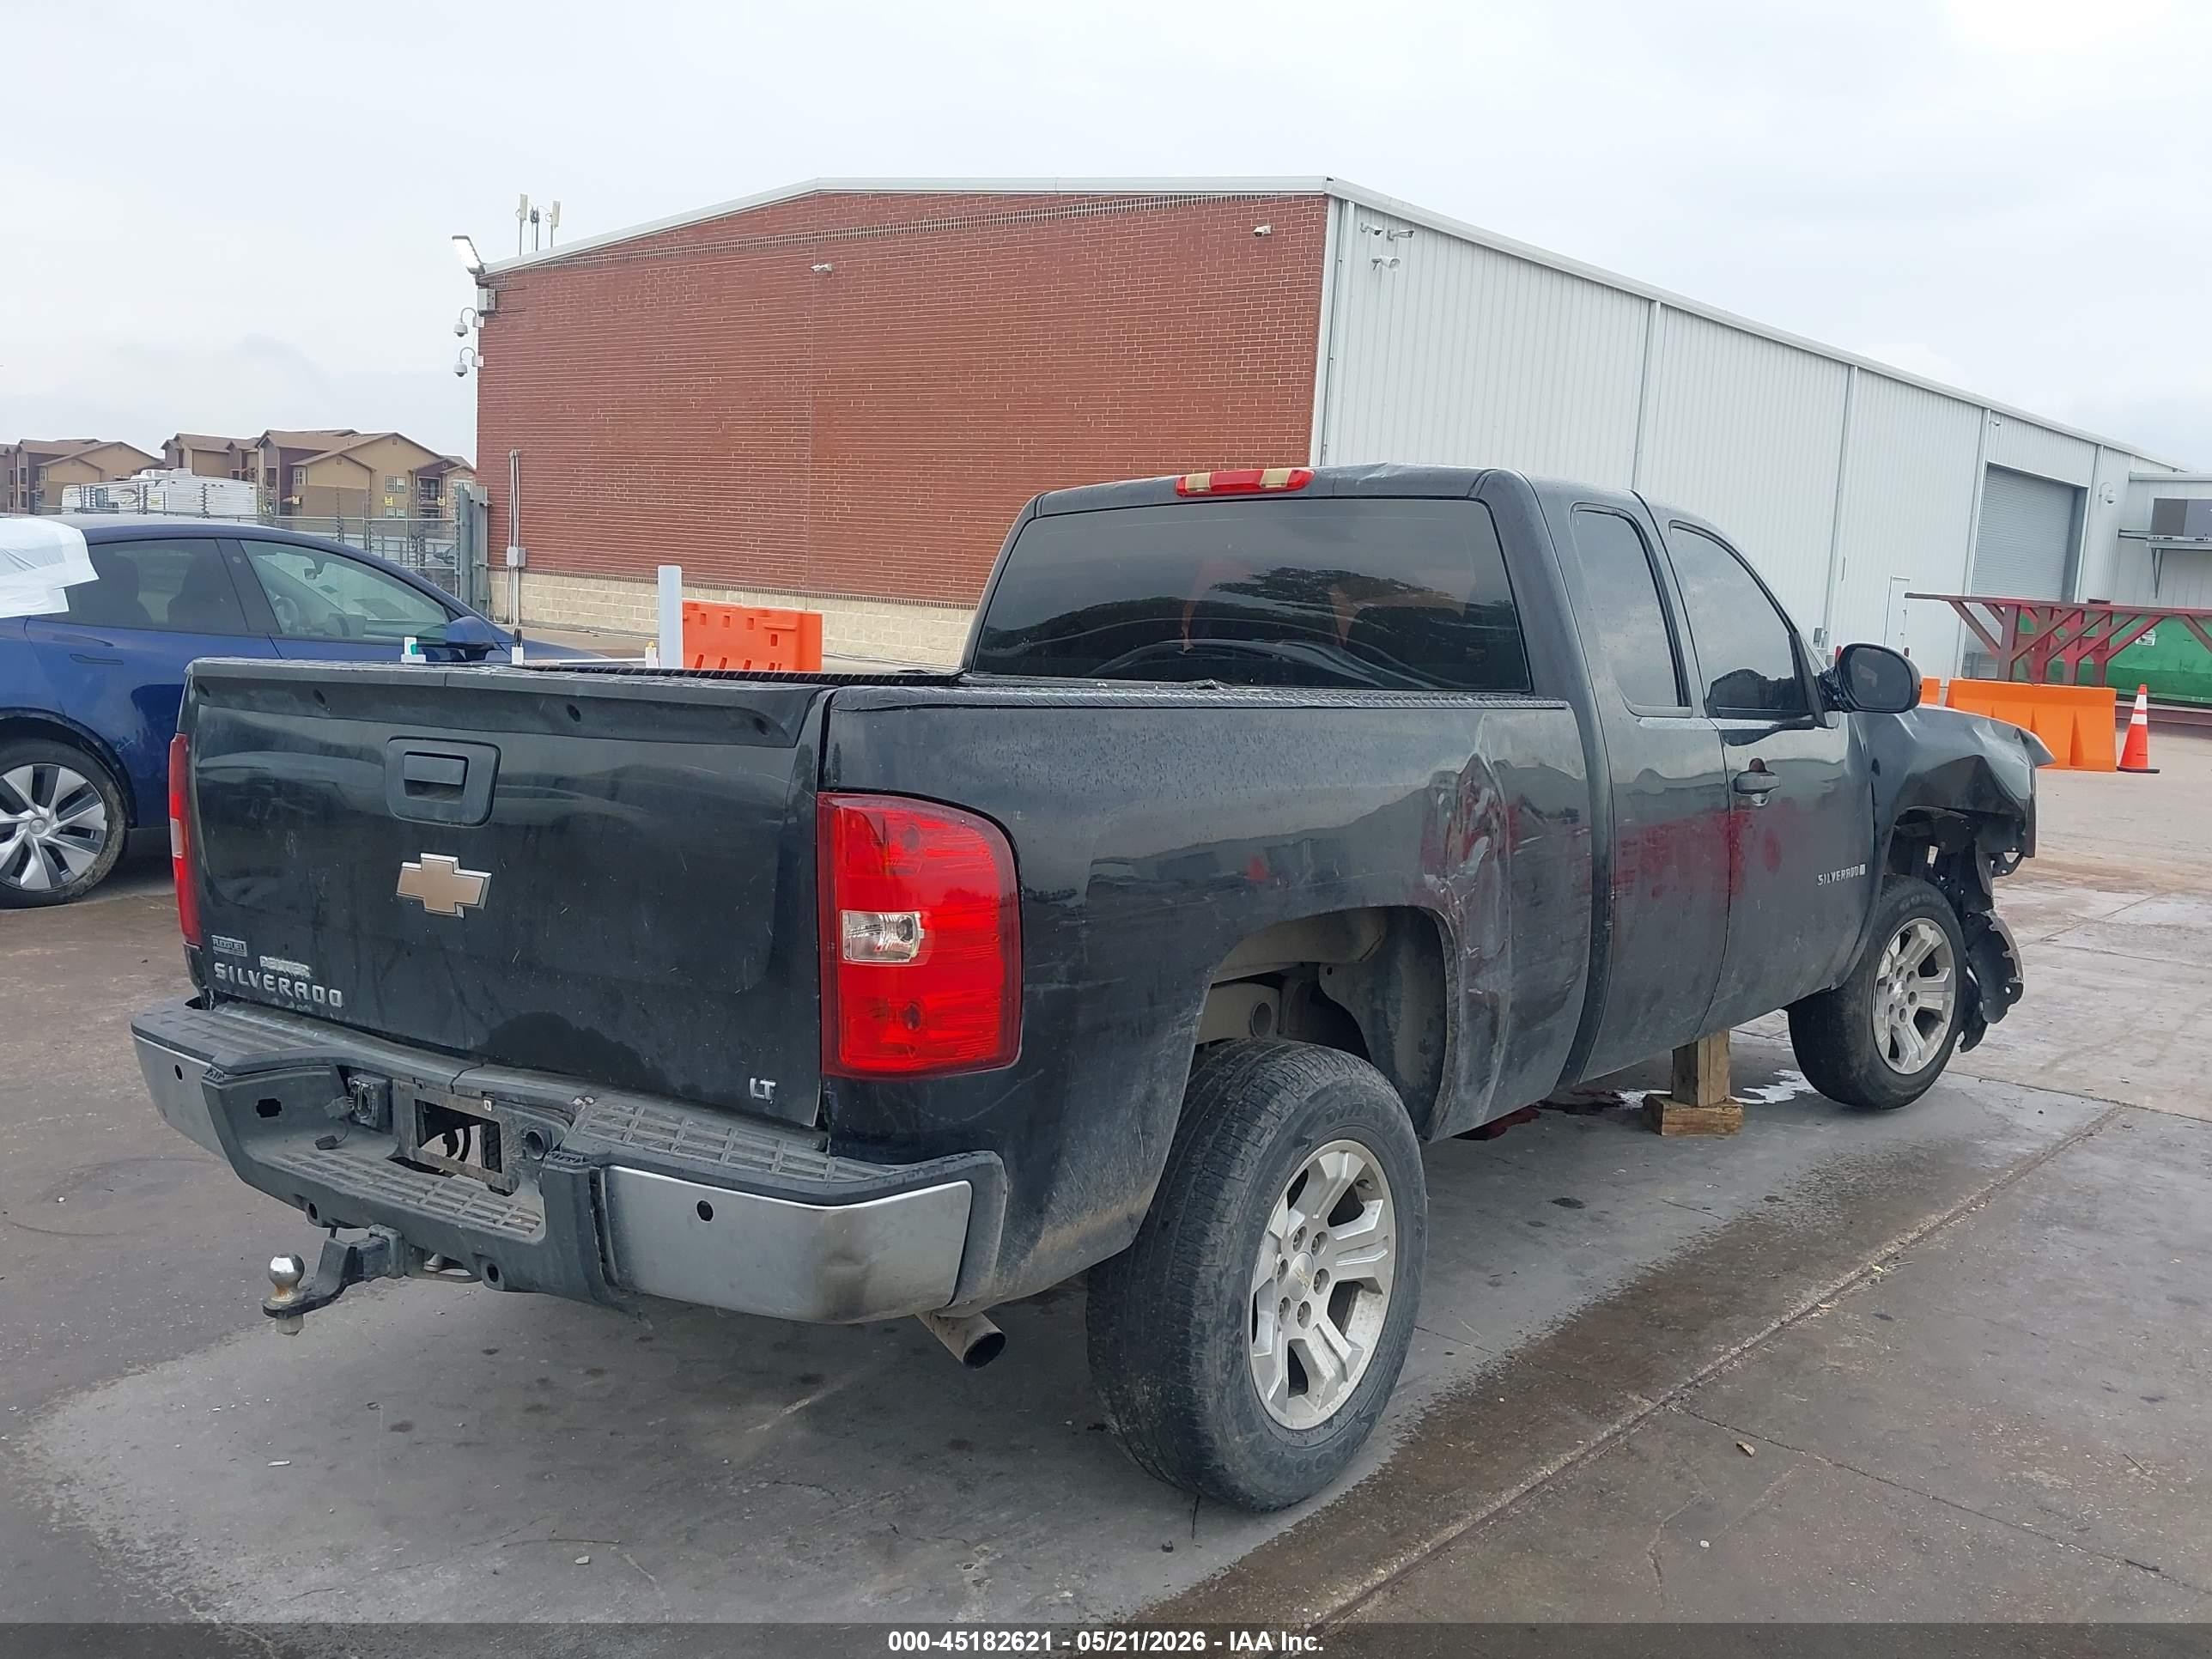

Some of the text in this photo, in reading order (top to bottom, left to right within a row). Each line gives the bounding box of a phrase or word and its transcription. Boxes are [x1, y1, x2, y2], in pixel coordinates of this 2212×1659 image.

[1817, 866, 1859, 886] SILVERADO
[214, 962, 343, 1008] SILVERADO
[750, 1078, 776, 1100] LT
